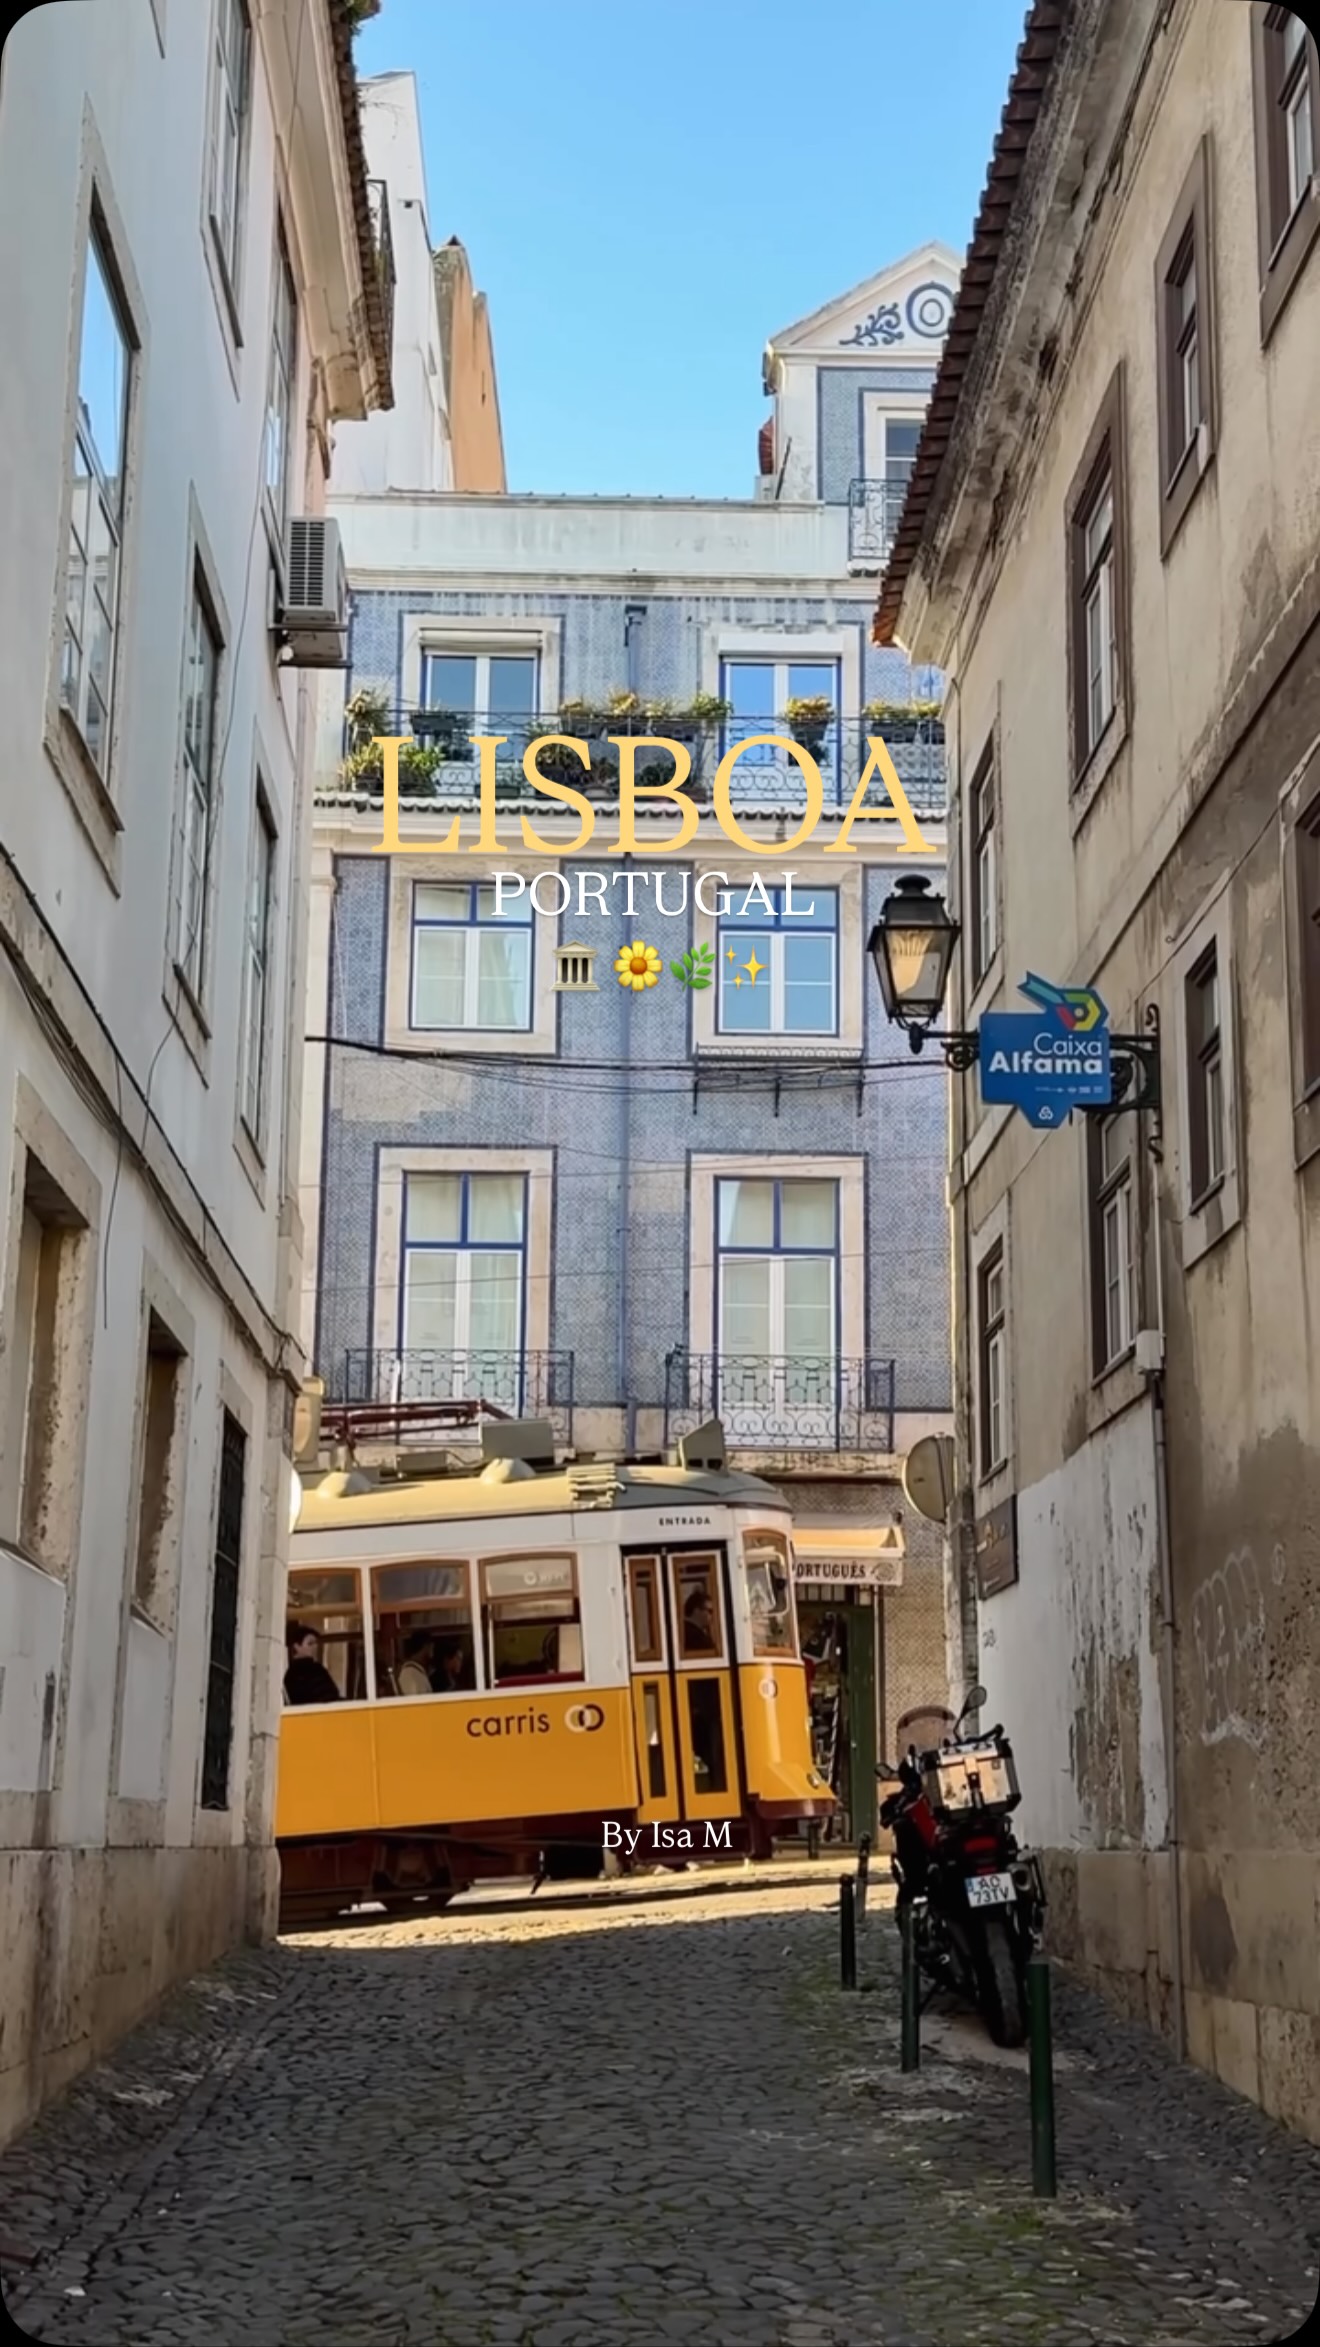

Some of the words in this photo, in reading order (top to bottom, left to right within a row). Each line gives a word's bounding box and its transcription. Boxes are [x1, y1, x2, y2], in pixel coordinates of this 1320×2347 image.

[1033, 1032, 1103, 1056] Caixa
[988, 1050, 1103, 1075] Alfama
[659, 1516, 711, 1526] ENTRADA
[466, 1706, 550, 1738] carris
